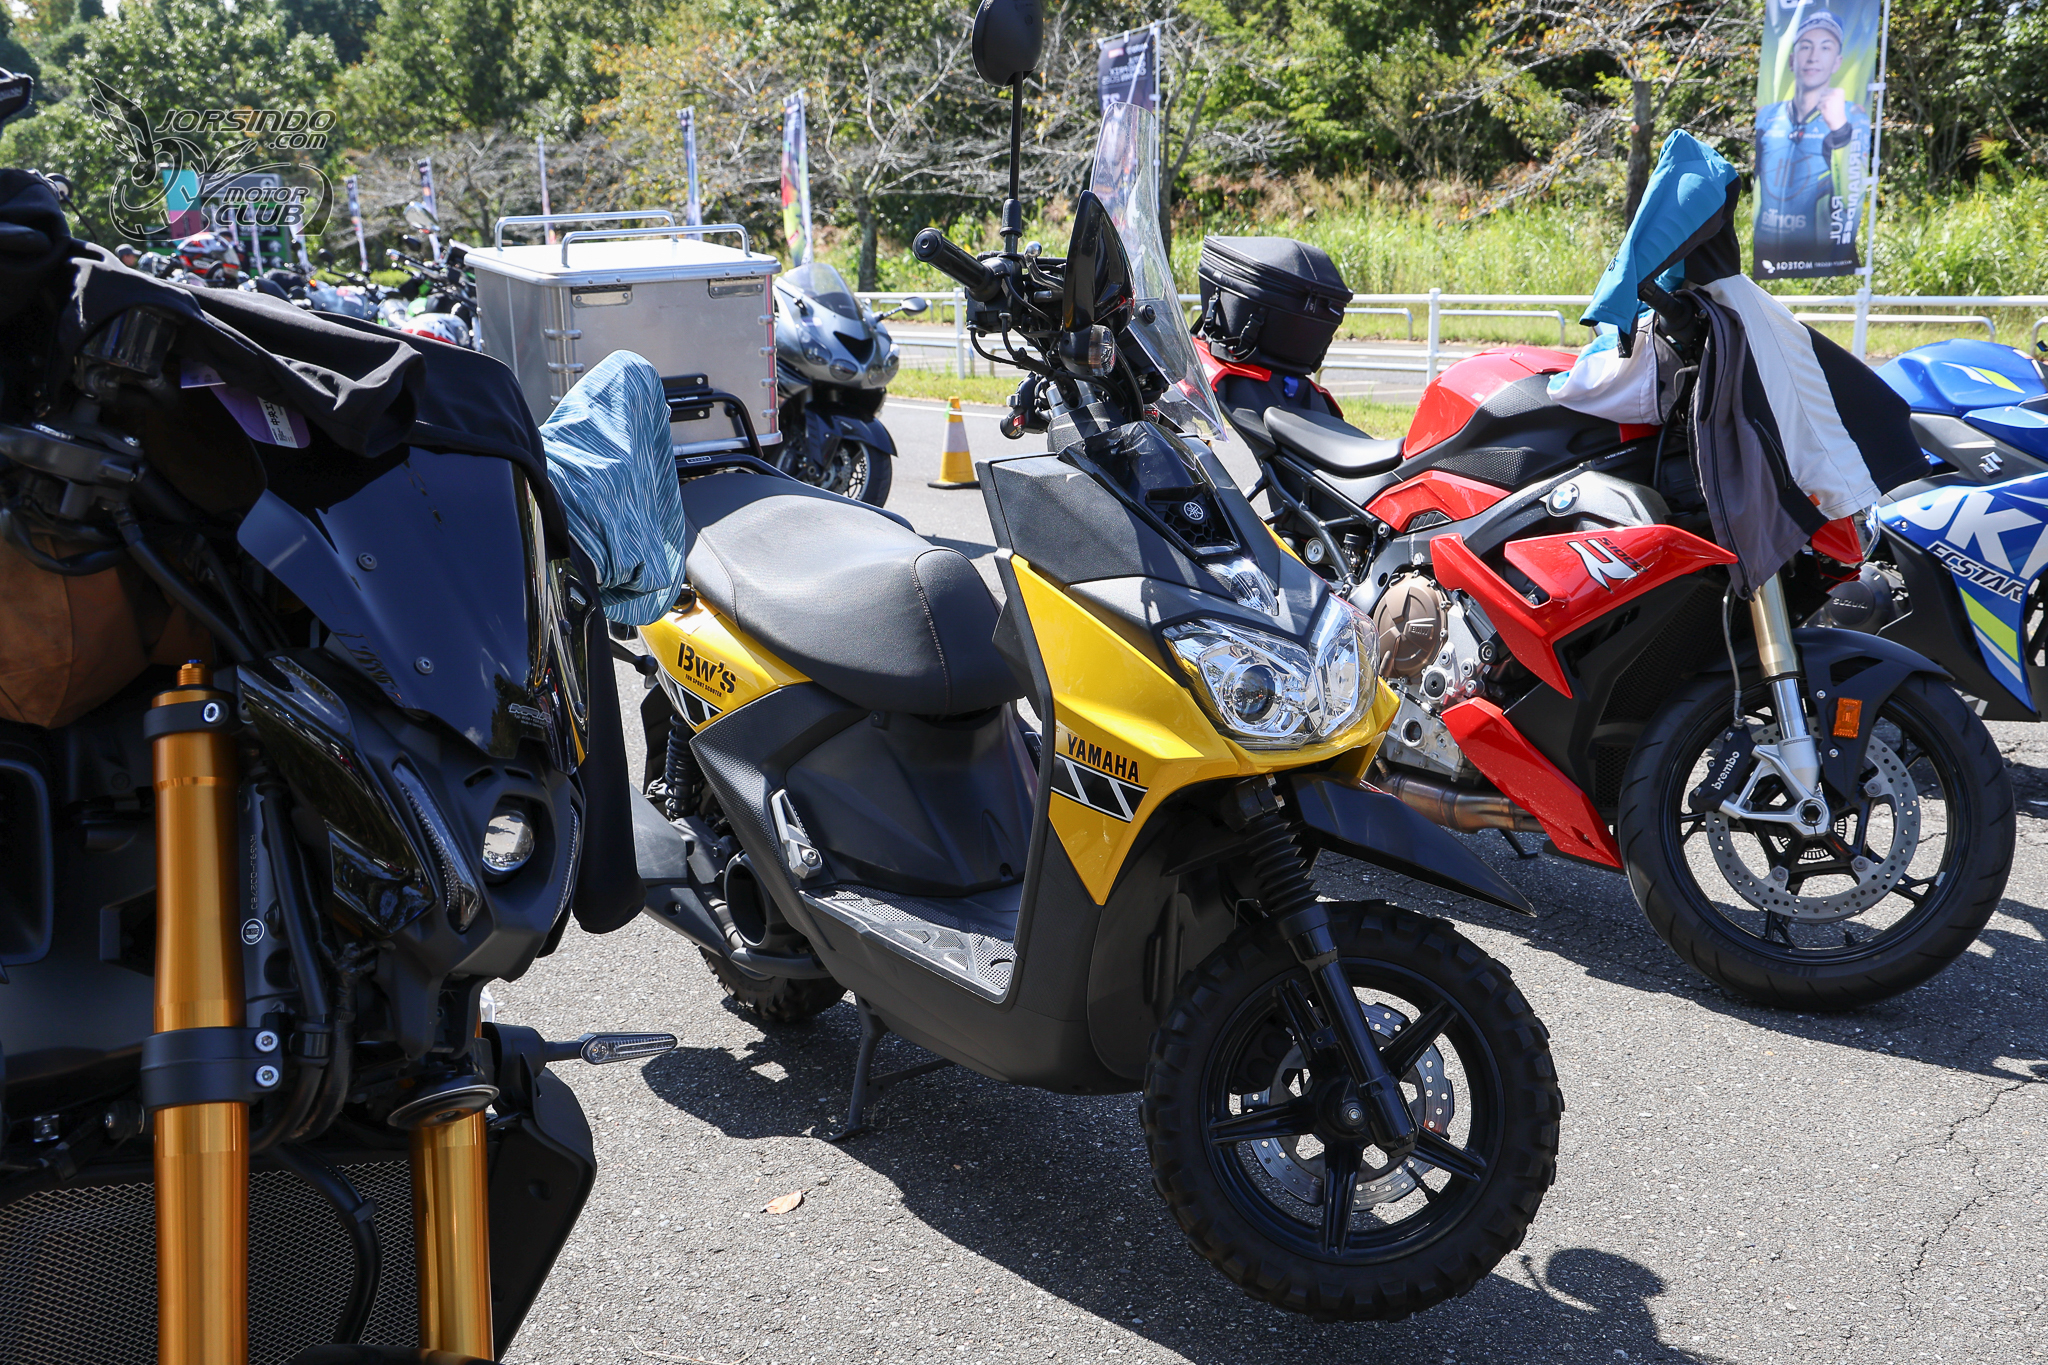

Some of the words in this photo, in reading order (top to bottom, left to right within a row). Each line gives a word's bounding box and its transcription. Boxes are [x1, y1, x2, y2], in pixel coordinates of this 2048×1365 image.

[1833, 597, 1868, 610] SUZUKI
[1067, 733, 1139, 783] YAMAHA
[1711, 751, 1740, 791] brembo
